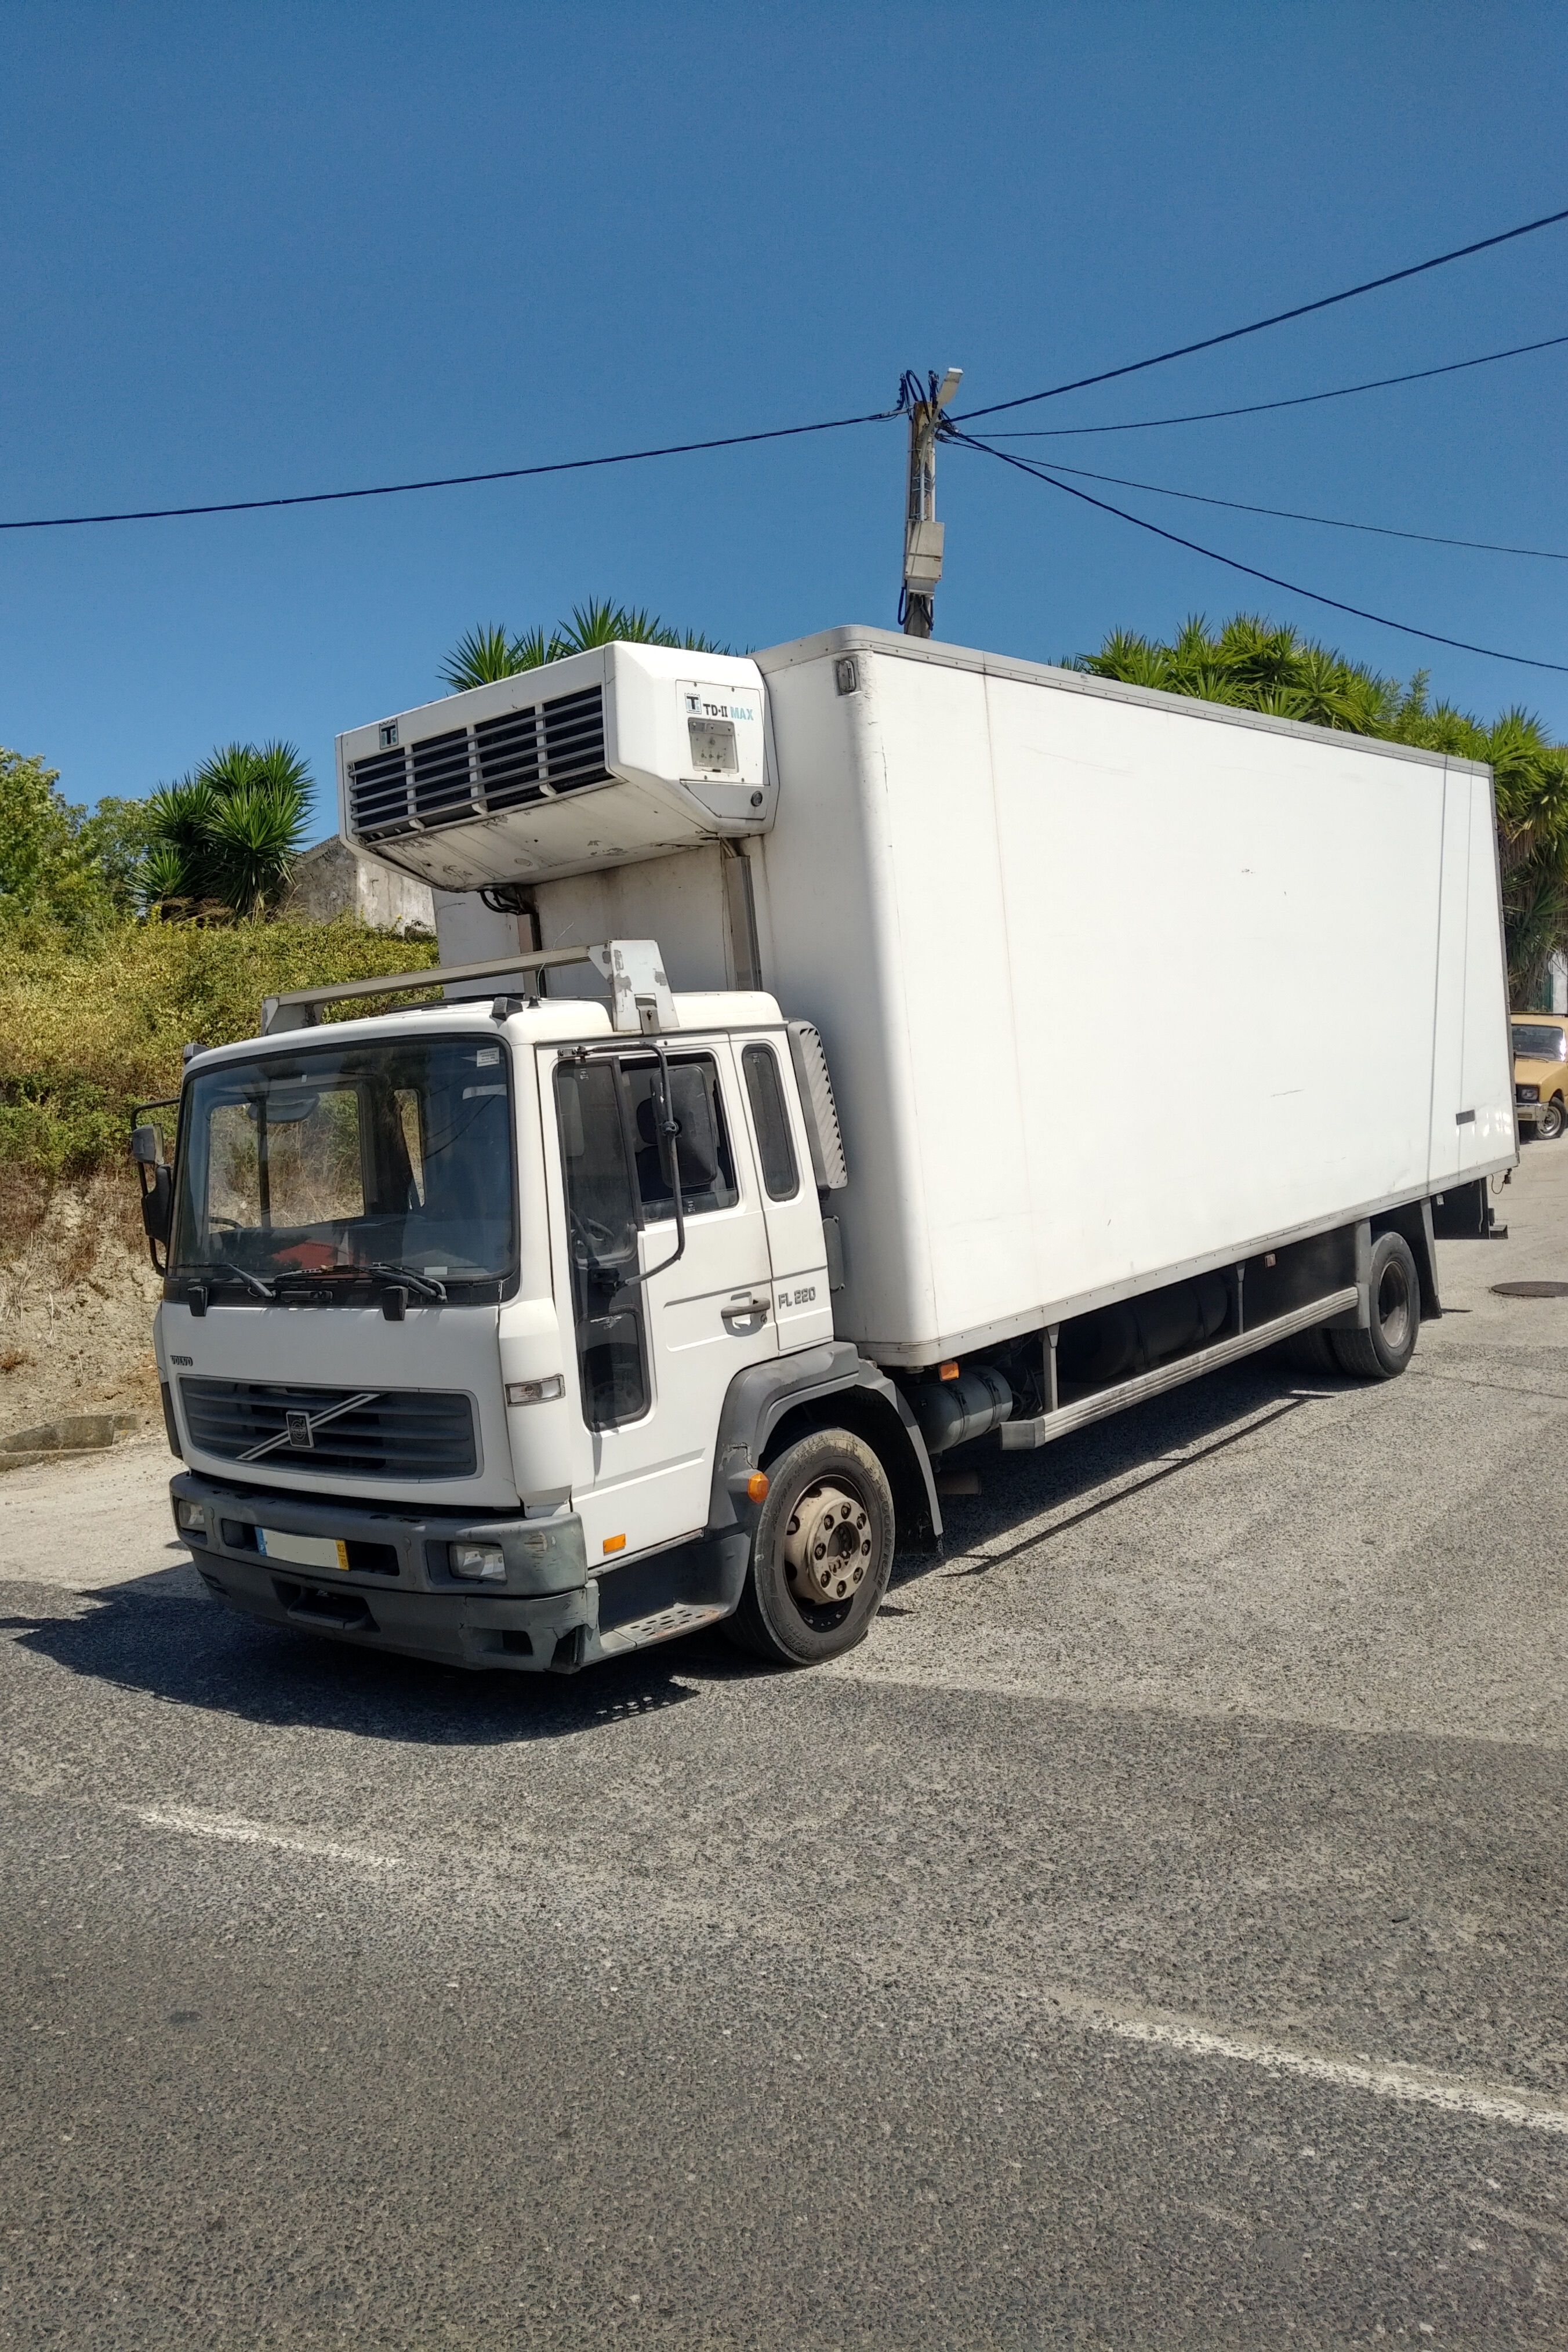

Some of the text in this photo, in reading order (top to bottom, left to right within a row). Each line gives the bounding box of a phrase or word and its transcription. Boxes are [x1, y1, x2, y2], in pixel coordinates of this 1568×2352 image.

[730, 706, 754, 721] MAX
[778, 1286, 816, 1309] FL 220
[170, 1355, 193, 1367] VOLVO
